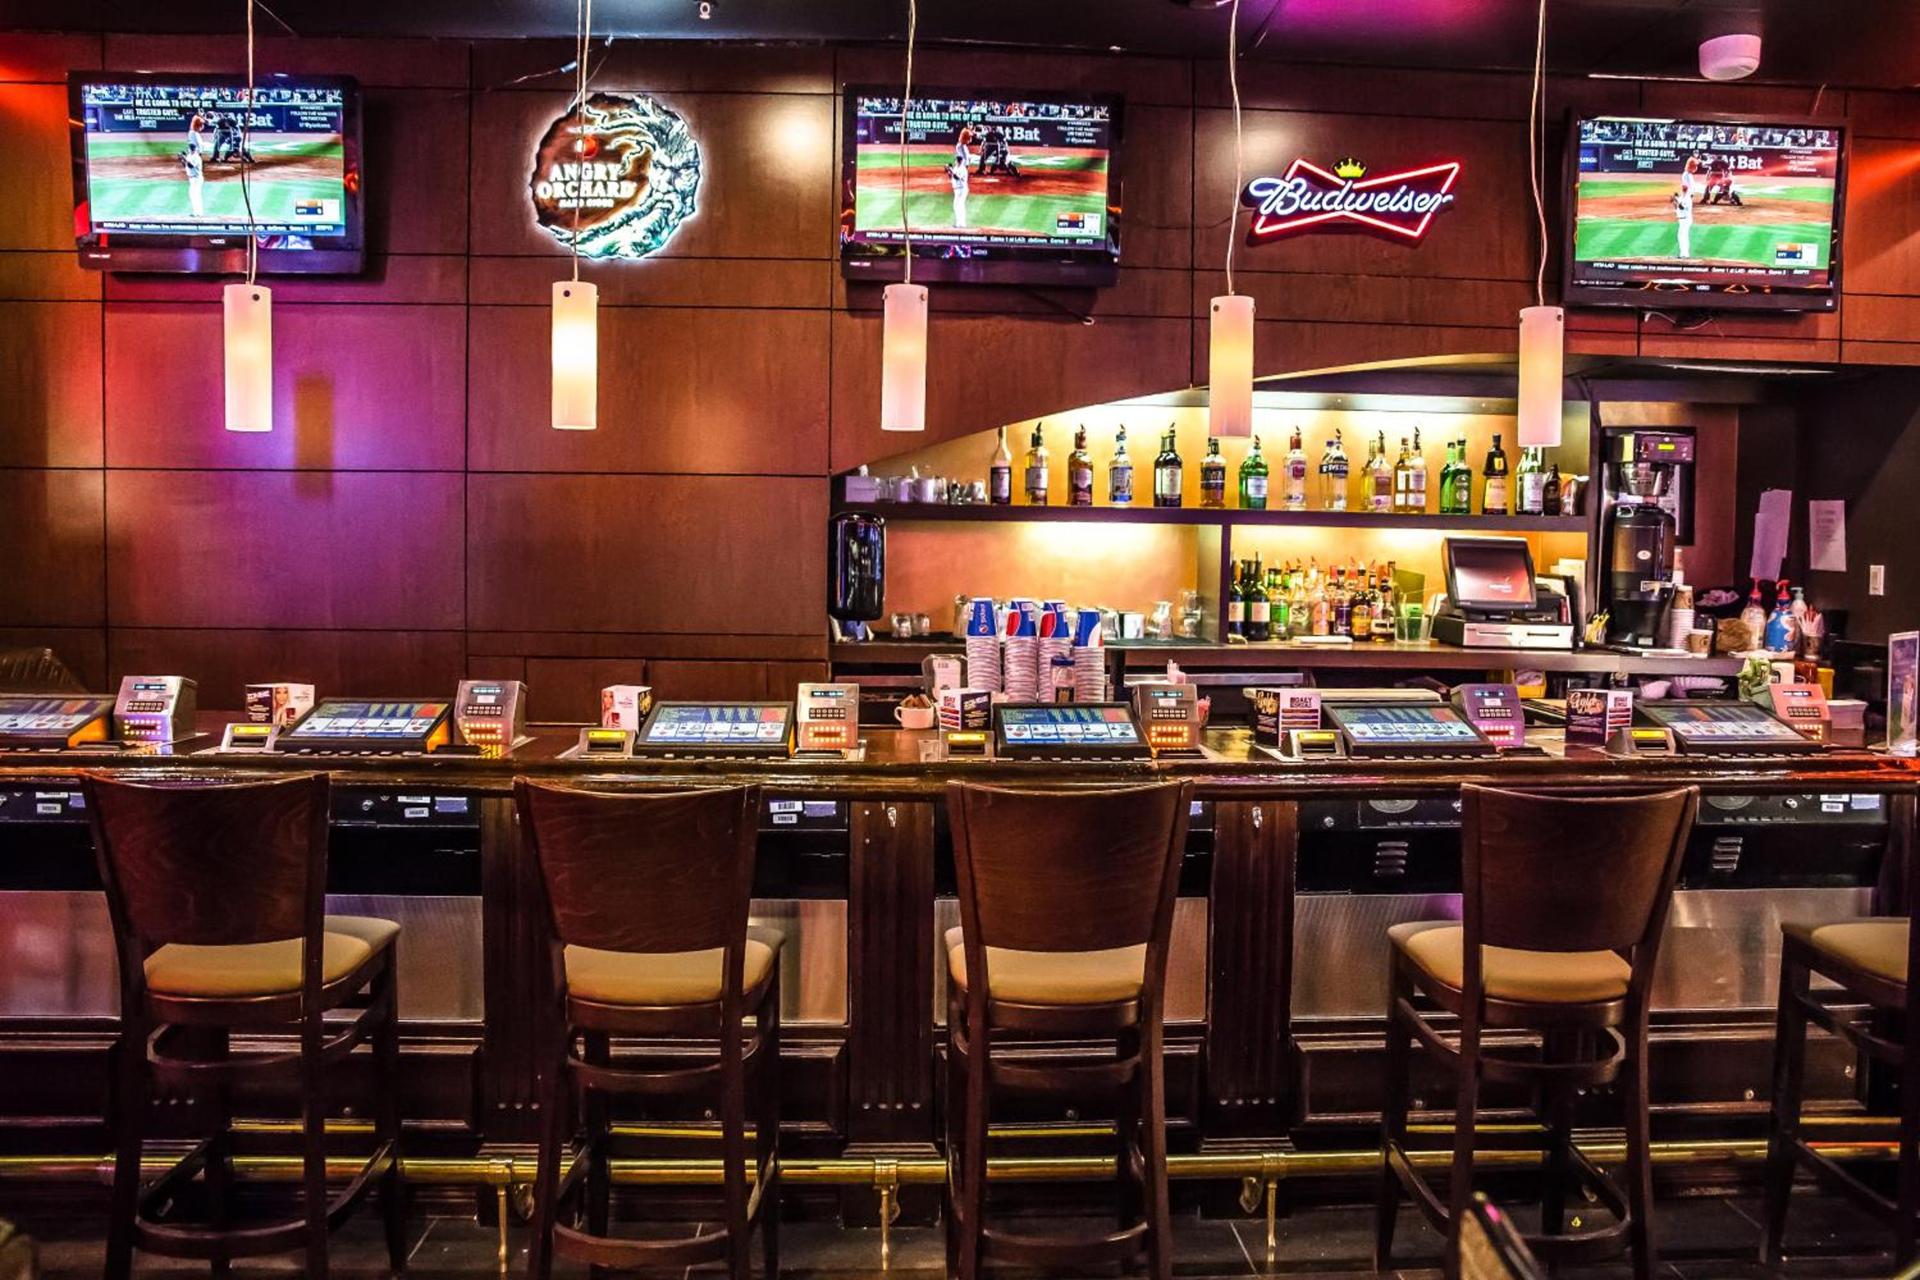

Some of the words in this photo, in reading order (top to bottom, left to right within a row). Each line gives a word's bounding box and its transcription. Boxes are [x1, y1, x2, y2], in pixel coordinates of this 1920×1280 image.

[245, 112, 274, 127] Bat
[1013, 126, 1040, 141] Bat
[1737, 155, 1763, 170] Bat
[549, 162, 622, 181] ANGRY
[535, 180, 637, 199] ORCHARD
[1249, 177, 1453, 216] Budweiser
